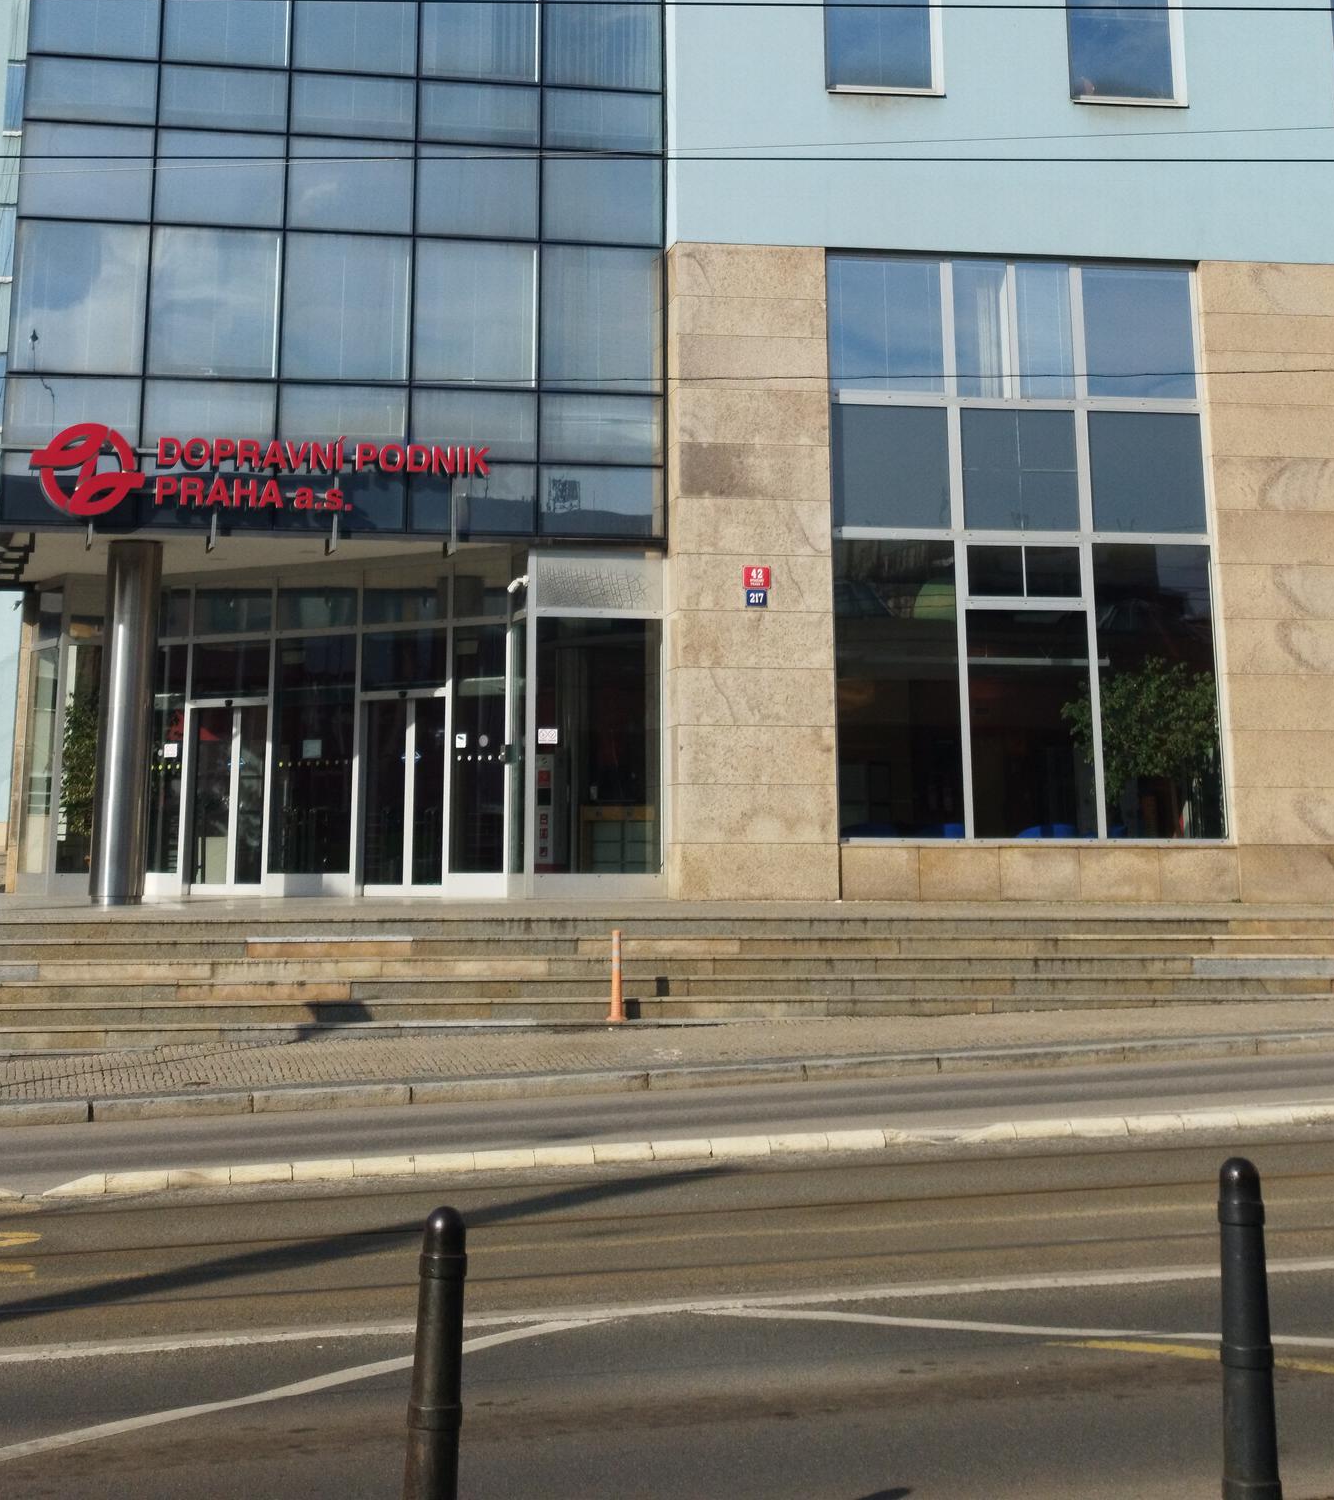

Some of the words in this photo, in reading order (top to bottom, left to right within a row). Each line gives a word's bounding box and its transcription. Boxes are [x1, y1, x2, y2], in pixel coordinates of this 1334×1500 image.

[157, 436, 346, 470] DOPRAVNÍ
[356, 443, 490, 475] PODNIK
[155, 477, 283, 508] PRAHA
[294, 486, 353, 511] a.s.
[751, 568, 763, 579] 42
[749, 593, 764, 604] 217
